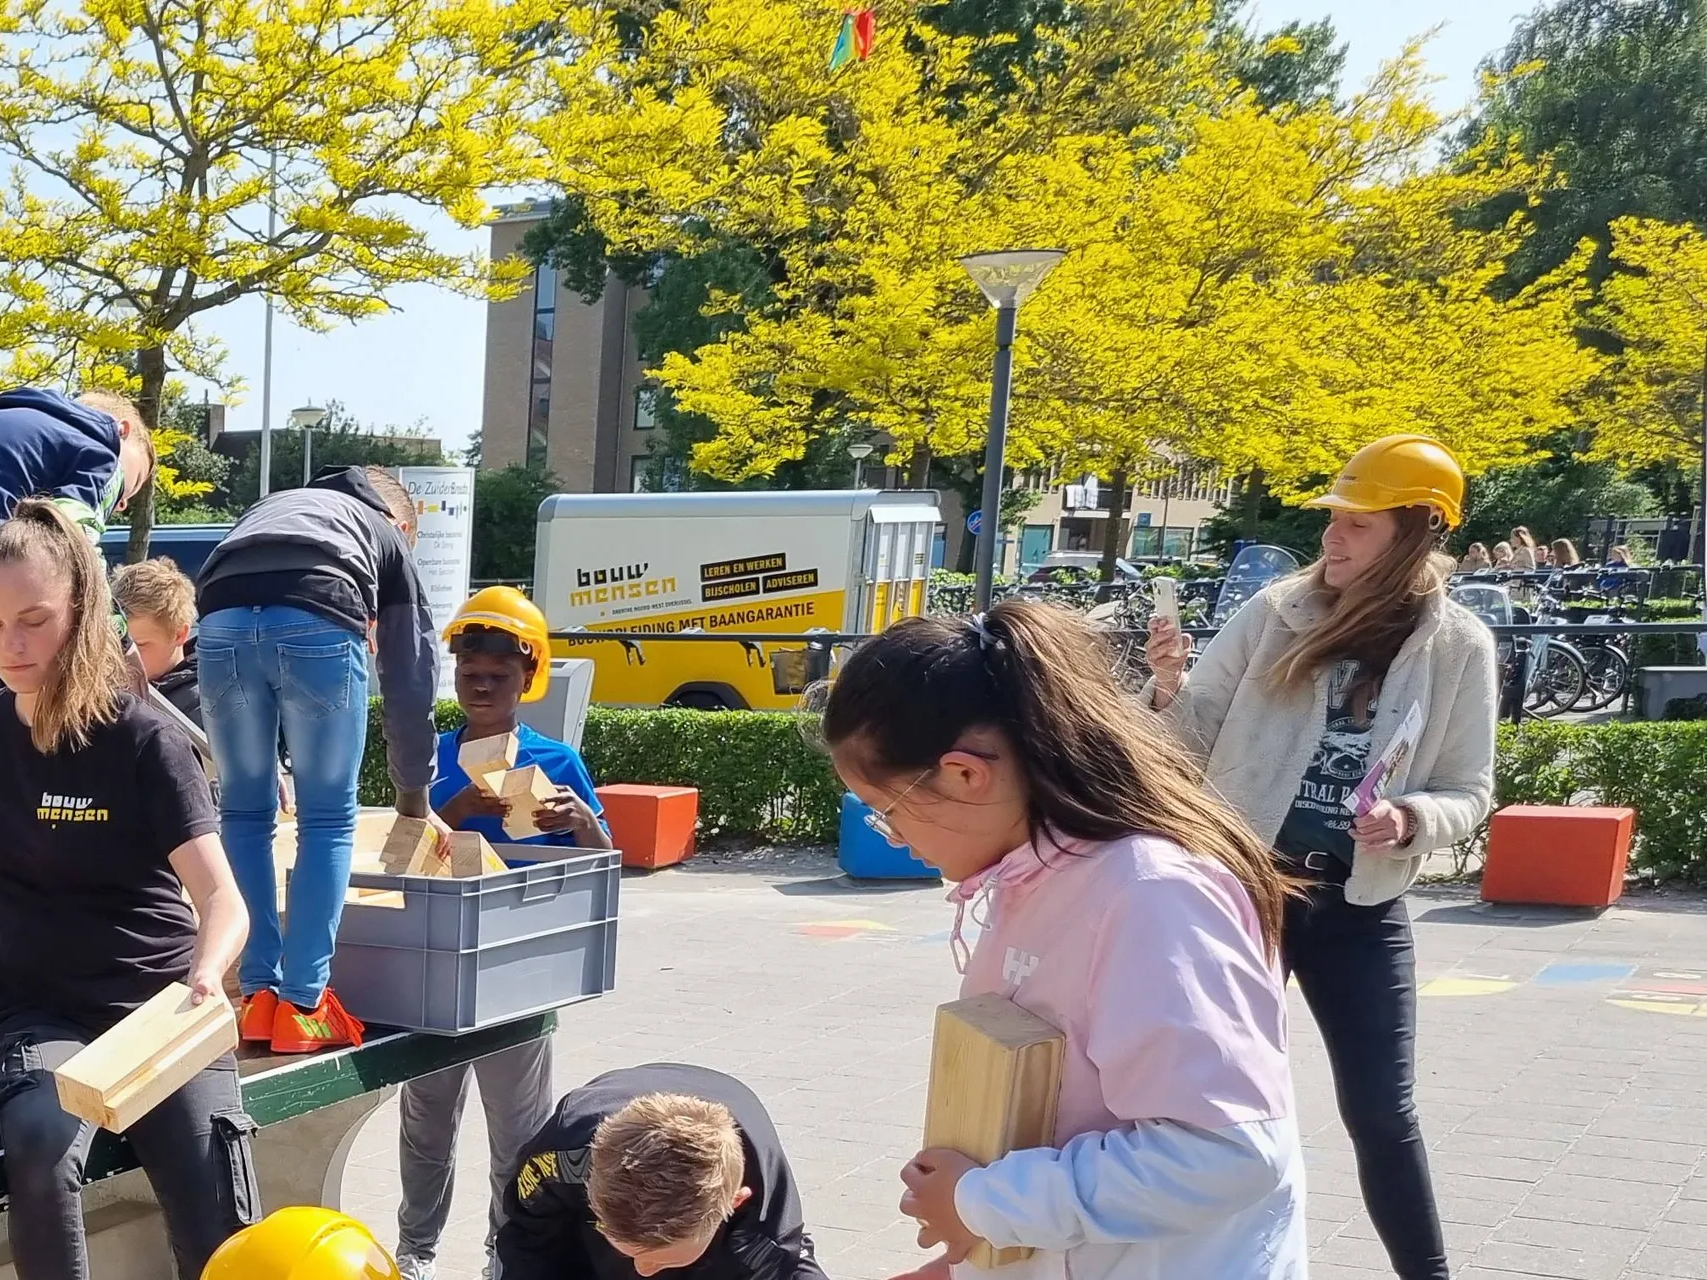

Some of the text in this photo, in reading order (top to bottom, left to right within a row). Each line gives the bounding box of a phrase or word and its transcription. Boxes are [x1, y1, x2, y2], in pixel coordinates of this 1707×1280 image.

[408, 481, 422, 495] De
[577, 562, 649, 588] bouw
[704, 557, 782, 578] LEREN EN WERKEN
[569, 577, 677, 608] mensen
[705, 573, 815, 597] BIJSCHOLEN ADVISEREN
[678, 616, 706, 634] MET
[709, 601, 815, 629] BAANGARANTIE
[41, 792, 93, 809] bouw
[36, 808, 108, 821] mensen
